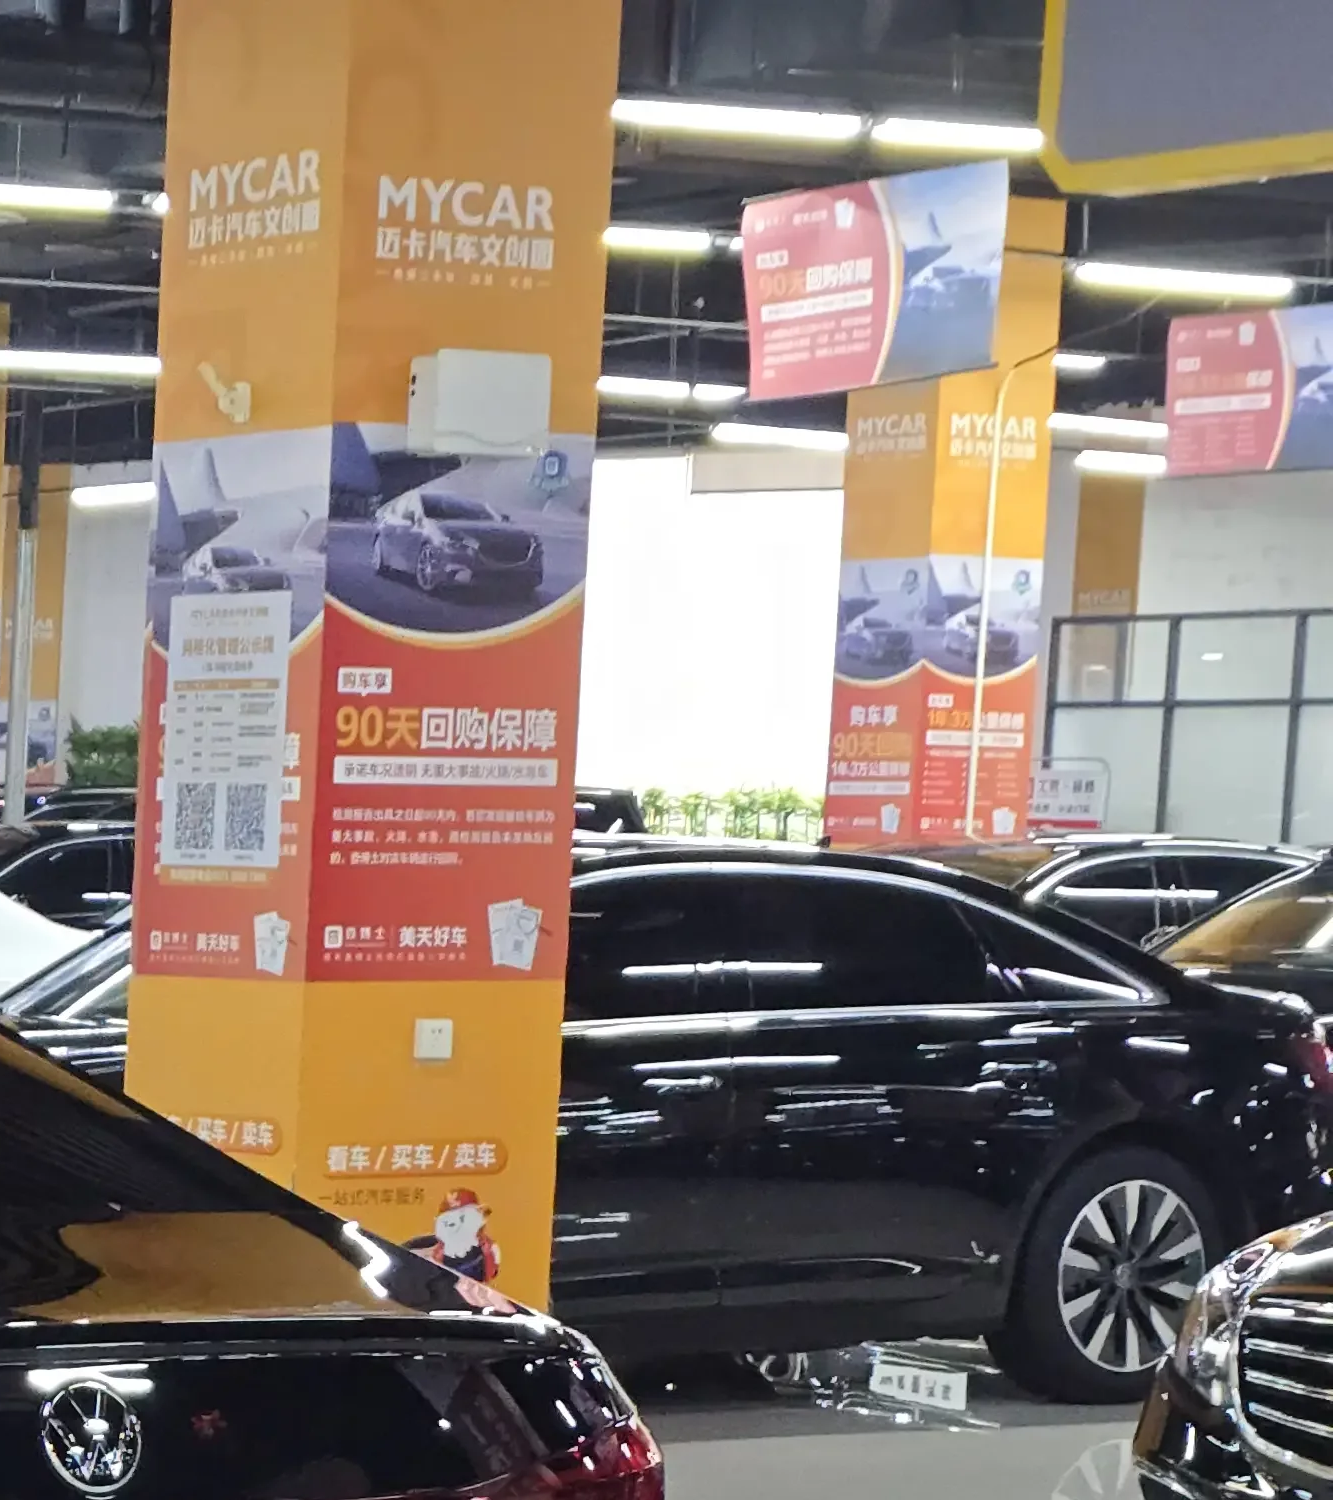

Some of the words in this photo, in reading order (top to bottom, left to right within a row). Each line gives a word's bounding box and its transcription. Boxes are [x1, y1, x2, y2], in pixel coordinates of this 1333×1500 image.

[189, 149, 321, 212] MYCAR
[378, 174, 554, 231] MYCAR
[336, 705, 558, 752] 90天回购保障
